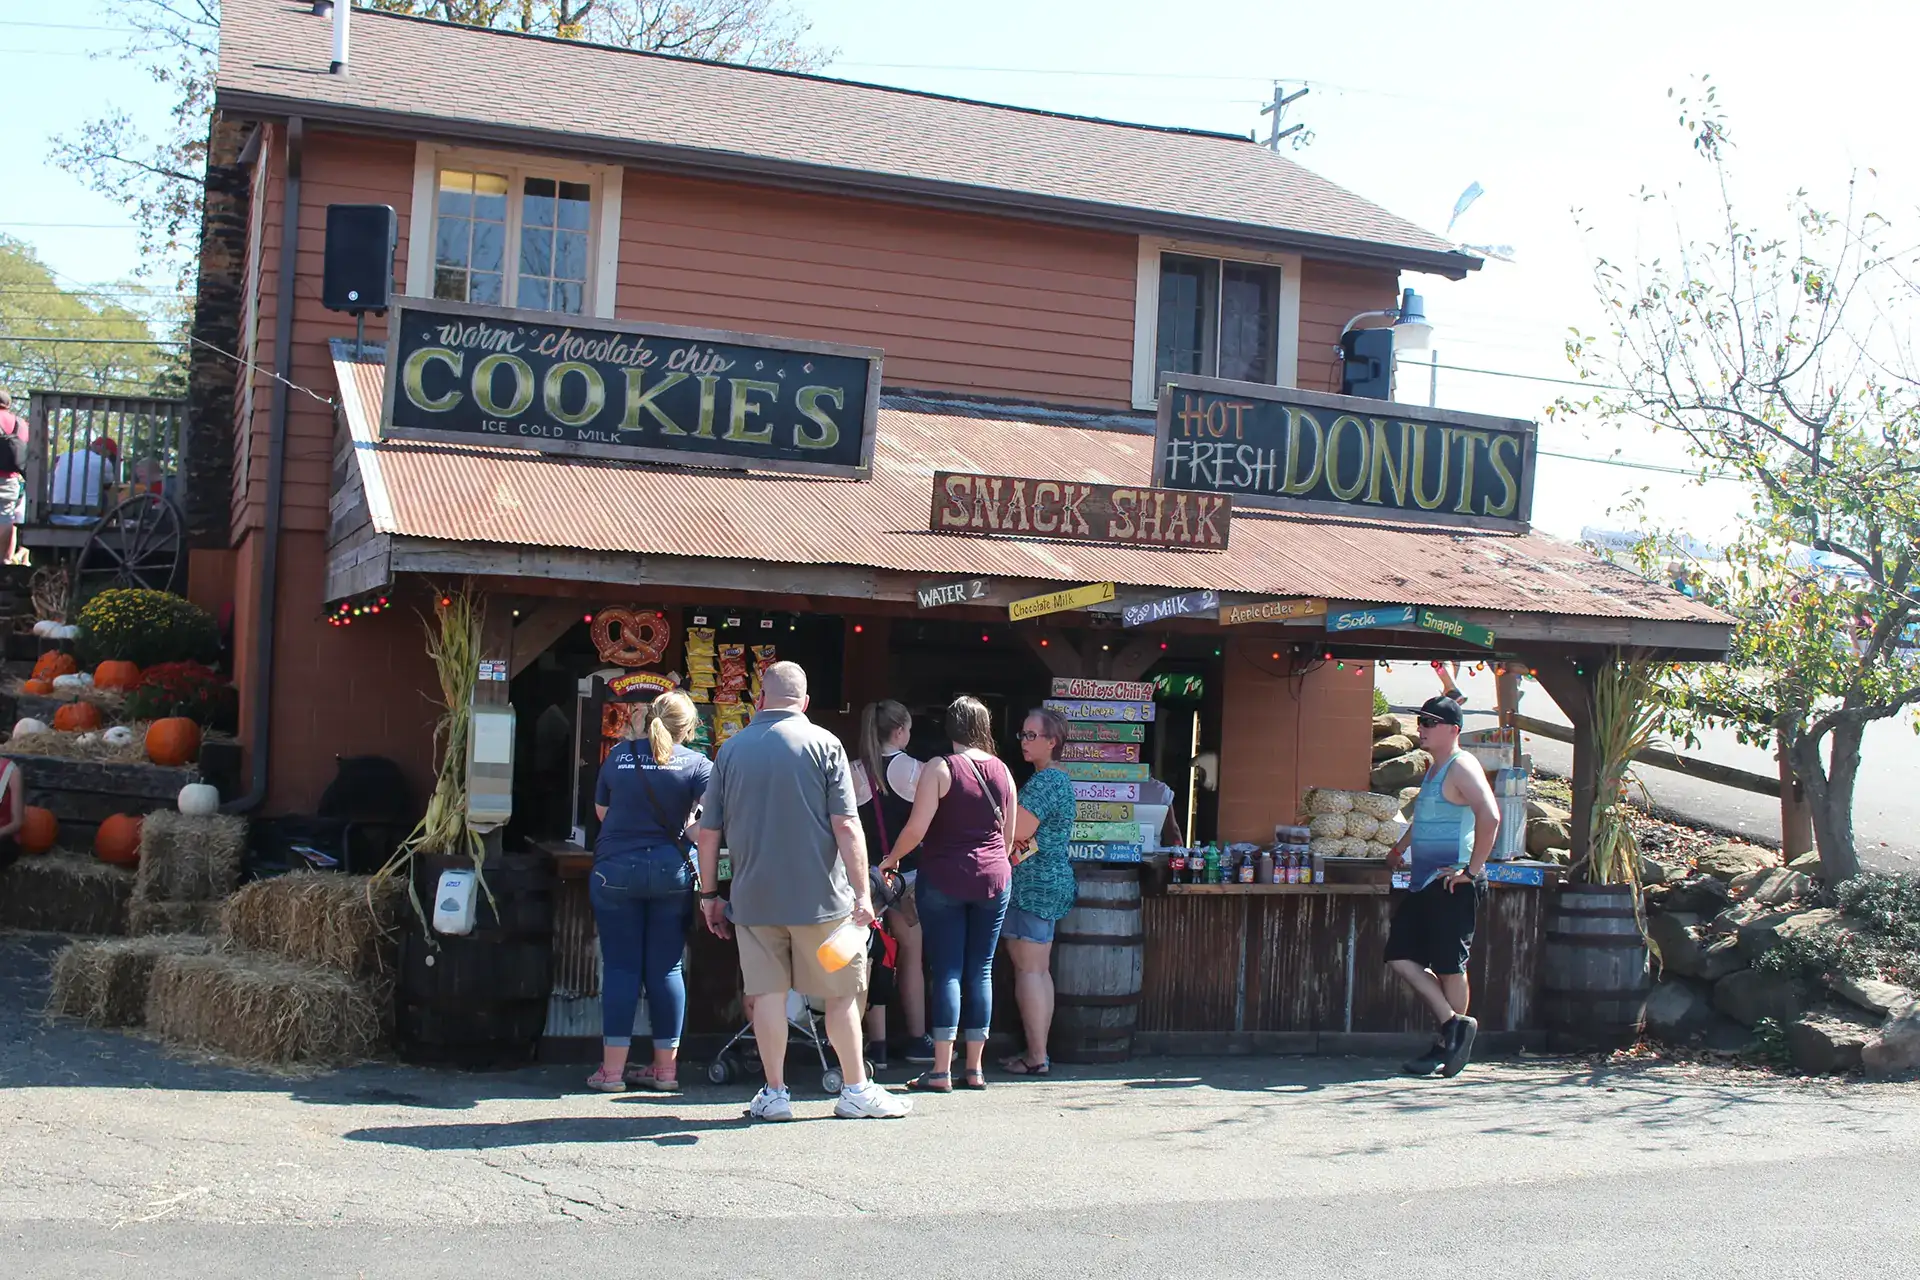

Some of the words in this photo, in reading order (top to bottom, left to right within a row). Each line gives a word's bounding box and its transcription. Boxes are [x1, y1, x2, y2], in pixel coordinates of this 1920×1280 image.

[530, 328, 658, 369] chocolate
[663, 344, 735, 375] chip
[403, 347, 844, 449] COOKIES
[1178, 395, 1254, 439] HOT
[481, 420, 507, 434] ICE
[519, 422, 563, 438] COLD
[578, 428, 621, 444] MILK
[1165, 437, 1278, 491] FRESH
[1280, 406, 1520, 517] DONUTS
[940, 475, 1092, 536] SNACK
[1108, 489, 1225, 545] SHAK
[918, 583, 967, 608] WATER
[971, 581, 985, 598] 2
[1013, 599, 1051, 617] Chocolate
[1053, 592, 1075, 609] Milk
[1102, 583, 1112, 599] 2
[1125, 605, 1139, 622] ICE
[1132, 604, 1150, 626] COLD
[1202, 590, 1217, 610] 2
[1230, 606, 1260, 624] Apple
[1262, 602, 1295, 619] Cider
[1304, 600, 1314, 614] 2
[1336, 612, 1377, 630] Soda
[1402, 606, 1413, 621] 2
[1422, 611, 1463, 637] Snapple
[1484, 631, 1495, 646] 3
[625, 684, 639, 692] SOFT
[640, 683, 664, 692] PRETZELS
[1114, 681, 1141, 700] Chili
[1141, 682, 1153, 701] 4
[1141, 704, 1151, 720] 5
[1131, 724, 1144, 742] 4
[668, 755, 690, 764] ORT
[1125, 746, 1136, 760] 5
[1127, 785, 1136, 799] 3
[1120, 805, 1130, 819] 3
[1067, 844, 1106, 860] NUTS
[1131, 853, 1141, 861] 10
[1133, 844, 1140, 854] 6
[1531, 870, 1540, 885] 3
